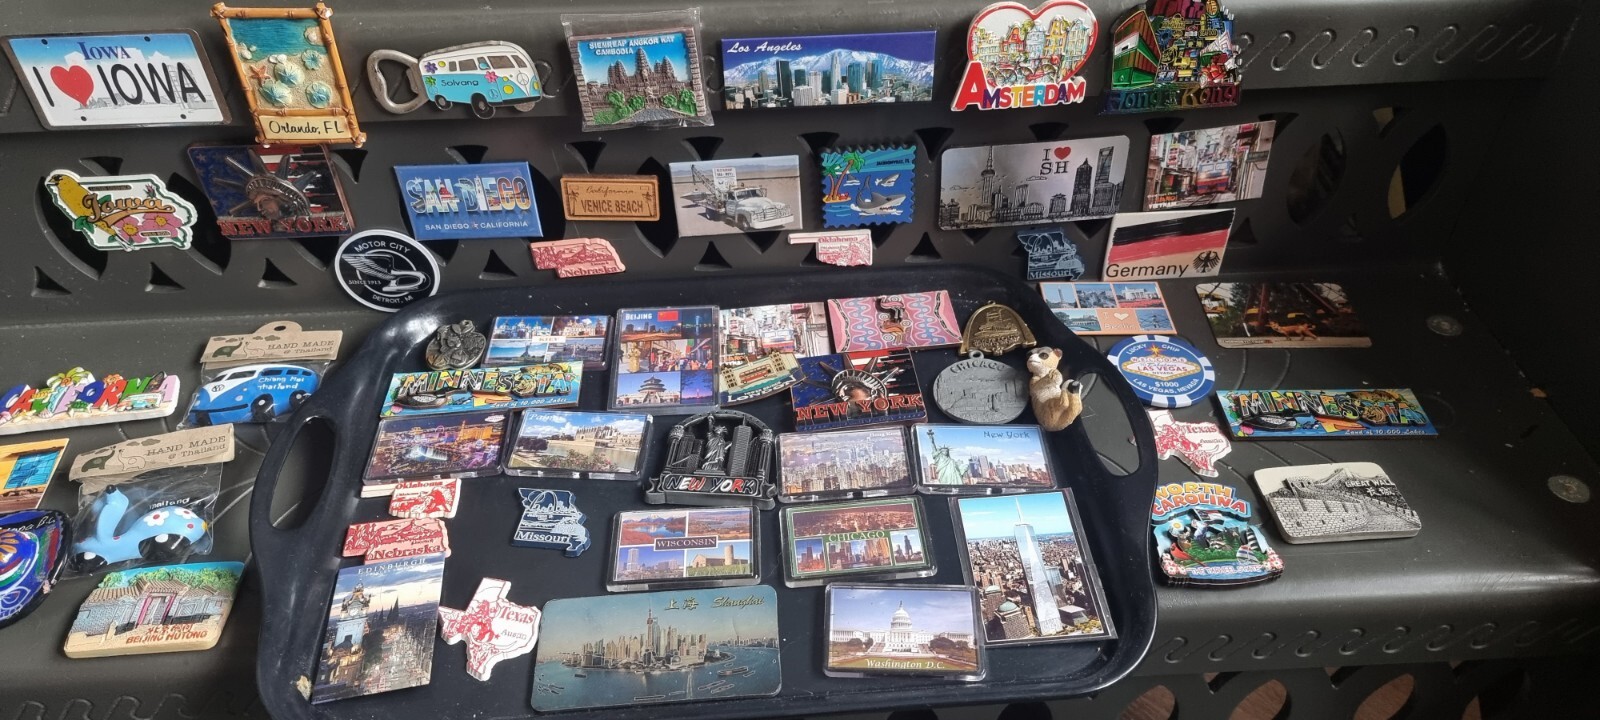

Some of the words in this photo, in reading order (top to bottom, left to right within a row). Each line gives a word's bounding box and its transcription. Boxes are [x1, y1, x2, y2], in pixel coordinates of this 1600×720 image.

[629, 38, 659, 47] ANGKOR
[727, 43, 749, 53] Los
[754, 42, 803, 53] Angeles
[32, 66, 54, 107] I
[96, 62, 206, 105] IOWA
[441, 79, 479, 87] Solvang
[951, 61, 1086, 111] AMSTERDAM
[268, 120, 321, 135] Orlando,
[324, 119, 344, 134] FL
[1042, 148, 1052, 162] I
[1040, 161, 1069, 175] SH
[405, 177, 460, 214] SAN
[456, 176, 532, 212] DIEGO
[586, 186, 635, 198] California
[82, 193, 170, 223] Iowa
[581, 200, 613, 213] VENICE
[615, 200, 643, 213] BEACH
[217, 219, 272, 236] NEW
[279, 216, 347, 234] YORK
[480, 221, 528, 229] CALIFORNIA
[354, 240, 386, 252] MOTOR
[389, 242, 411, 254] CITY
[563, 266, 617, 277] Nebraska
[1030, 270, 1071, 278] Missouri
[1105, 263, 1189, 279] Germany
[268, 342, 298, 350] HAND
[303, 340, 334, 348] MADE
[294, 346, 333, 354] Thailand
[1126, 343, 1147, 355] LUCKY
[1162, 343, 1180, 352] CHIP
[949, 361, 1005, 374] CHICAGO
[400, 371, 572, 397] MINNESOTA
[1133, 378, 1146, 388] LAS
[1148, 386, 1177, 394] VEGAS,
[1179, 378, 1199, 392] NEVADA
[796, 401, 848, 420] NEW
[856, 393, 924, 414] YORK
[1239, 391, 1428, 425] MINNESOTA
[983, 430, 1004, 439] New
[1006, 430, 1030, 440] York
[1187, 425, 1217, 433] Texas
[146, 443, 183, 457] HAND
[189, 435, 226, 449] MADE
[180, 444, 226, 457] Thailand
[395, 480, 443, 489] Oklahoma
[667, 475, 706, 492] NEW
[710, 477, 755, 494] YORK
[1374, 478, 1396, 486] WALL
[1156, 482, 1232, 499] NORTH
[1152, 493, 1247, 516] CAROLINA
[518, 531, 570, 543] Missouri
[656, 537, 717, 548] WISCONSIN
[828, 530, 886, 542] CHICAGO
[374, 545, 441, 559] Nebraska
[358, 558, 427, 575] EDINBURGH
[664, 598, 699, 611] 上海
[711, 595, 765, 609] Shanghai
[499, 605, 535, 624] Texas
[126, 634, 164, 645] BEIJING
[165, 630, 208, 641] HUTONG
[501, 628, 527, 640] Austin
[866, 658, 922, 669] Washington
[925, 661, 946, 669] D.C.
